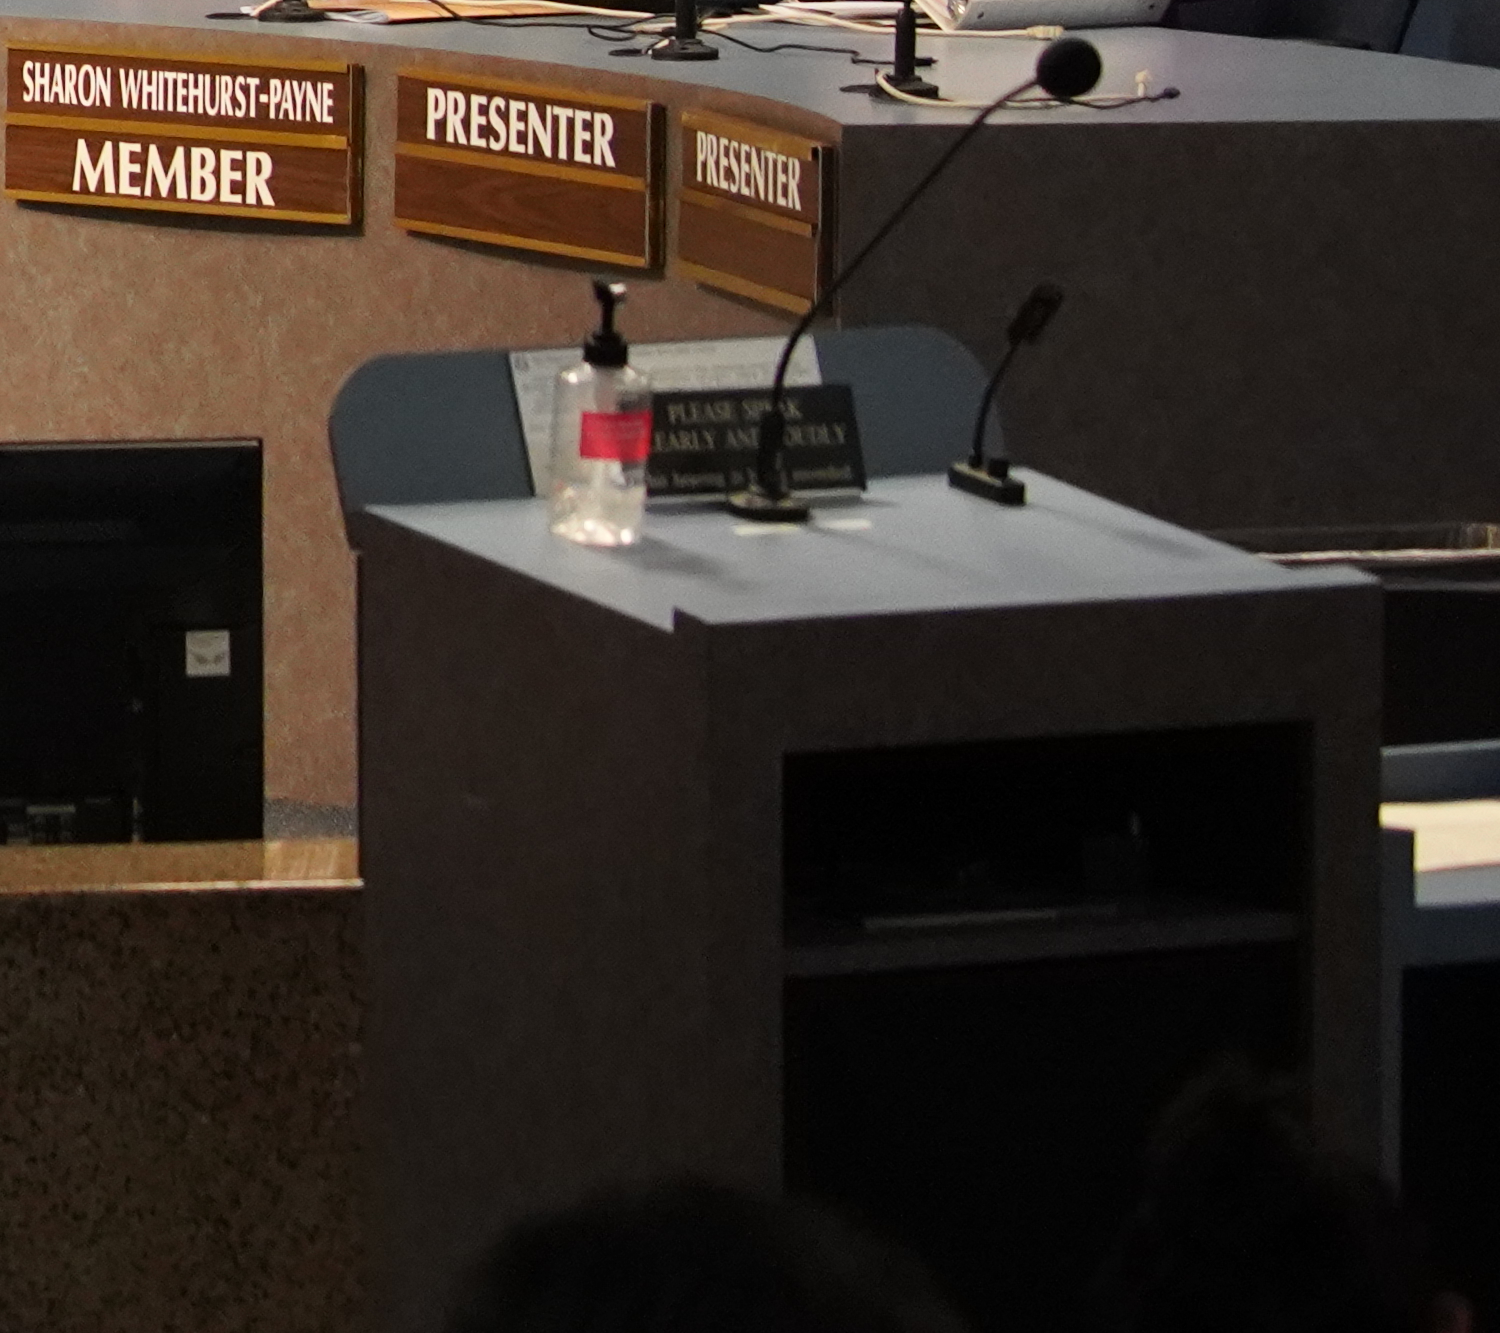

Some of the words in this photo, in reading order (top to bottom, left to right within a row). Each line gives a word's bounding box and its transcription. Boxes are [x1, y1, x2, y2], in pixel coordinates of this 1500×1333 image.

[22, 60, 112, 108] SHARON
[118, 69, 334, 124] WHITEHURST-PAYNE
[426, 87, 617, 169] PRESENTER
[72, 138, 275, 207] MEMBER
[695, 129, 801, 211] PRESENTER
